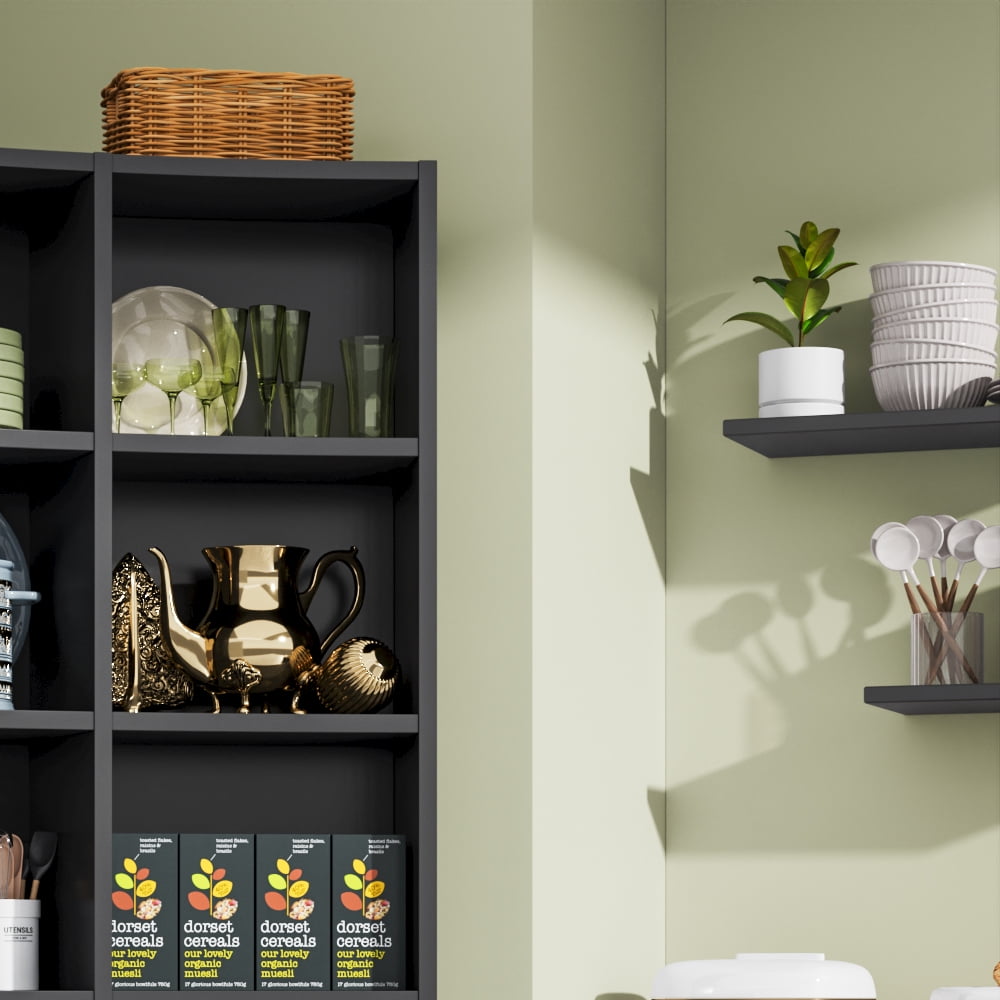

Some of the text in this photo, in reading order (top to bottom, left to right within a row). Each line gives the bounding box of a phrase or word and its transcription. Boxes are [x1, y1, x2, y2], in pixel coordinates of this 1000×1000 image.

[184, 920, 234, 933] dorset
[261, 920, 310, 933] dorset
[337, 920, 386, 933] dorset
[184, 934, 240, 947] cereals
[261, 934, 316, 947] cereals
[337, 934, 392, 947] cereals
[128, 949, 157, 959] lovely
[184, 949, 233, 959] our lovely
[261, 949, 309, 959] our lovely
[337, 949, 385, 959] our lovely
[184, 959, 221, 969] organic
[261, 959, 298, 969] organic
[337, 959, 374, 969] organic
[184, 969, 218, 978] muesli
[261, 969, 294, 978] muesli
[337, 969, 370, 978] muesli
